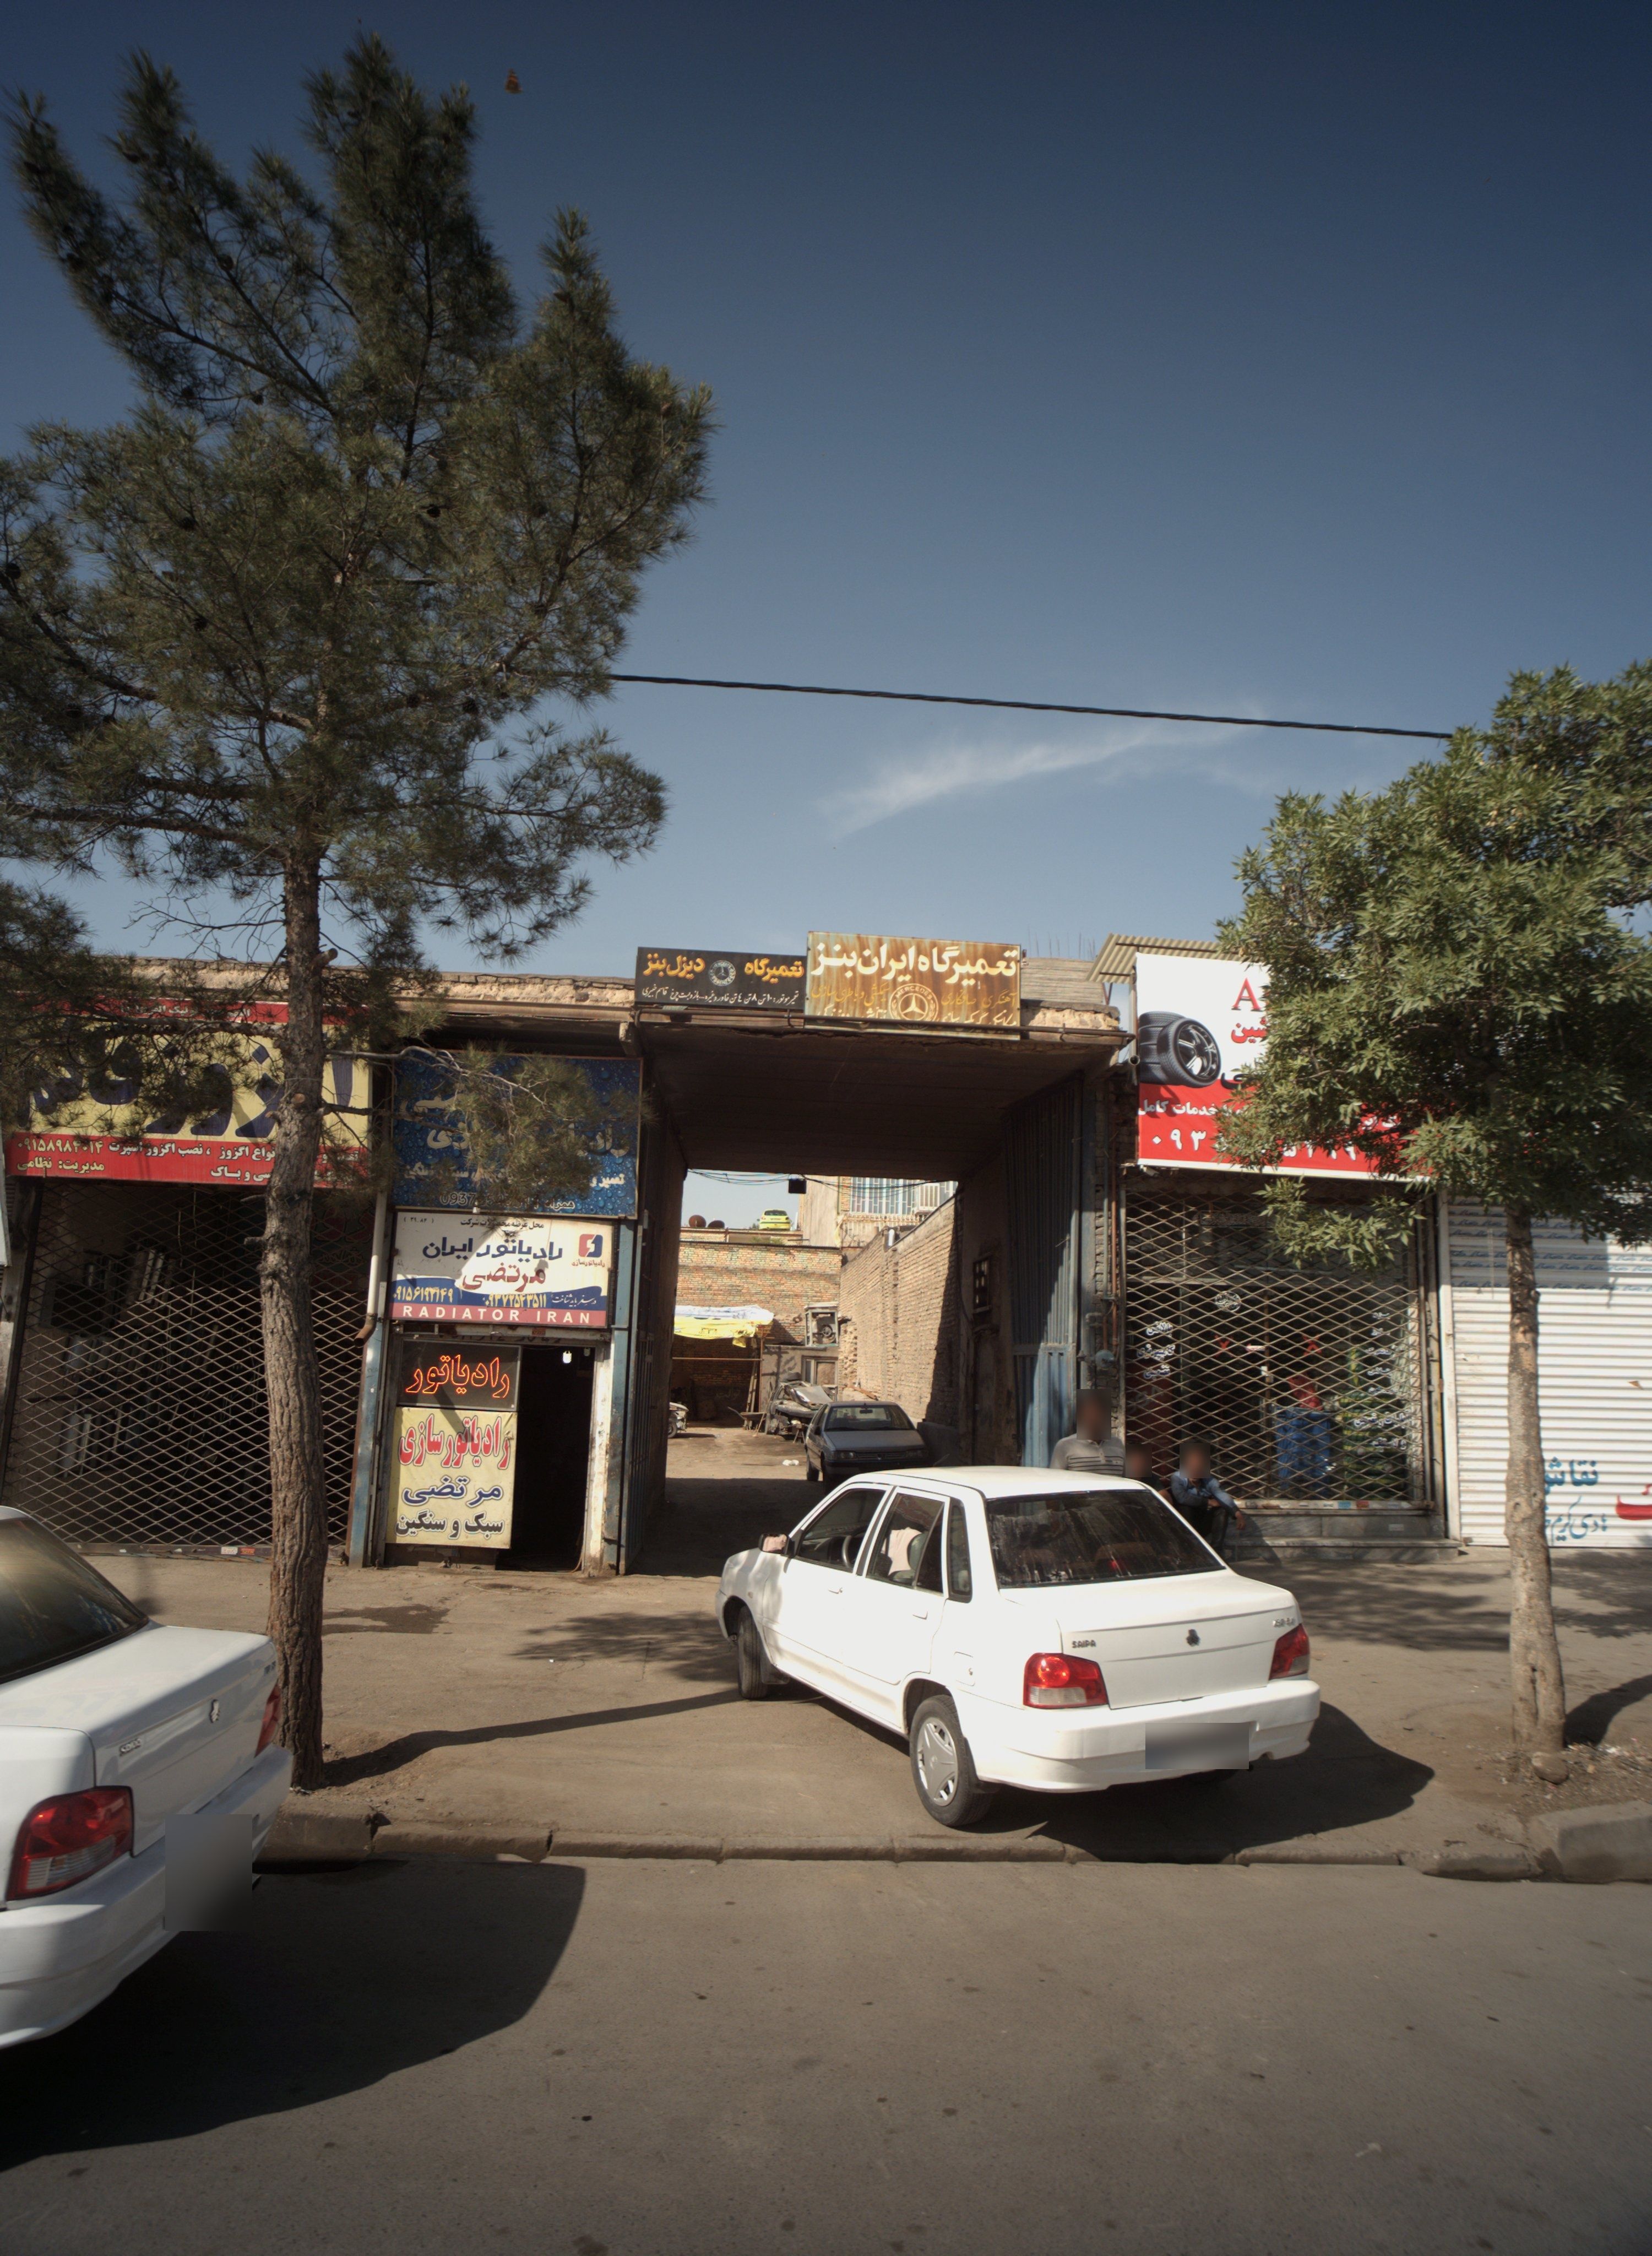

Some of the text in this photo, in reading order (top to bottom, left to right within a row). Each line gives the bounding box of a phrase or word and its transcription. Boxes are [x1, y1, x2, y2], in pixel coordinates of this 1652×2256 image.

[643, 953, 667, 977] بنز
[666, 955, 705, 979] دیزل
[745, 958, 805, 984] تعمیرگاه
[811, 942, 1018, 986] تعمیرگاه ایران بنز
[1138, 1099, 1169, 1115] کامل
[1172, 1101, 1219, 1116] خدمات
[178, 1143, 203, 1158] نصب
[219, 1145, 249, 1160] اگزوز
[252, 1146, 275, 1161] نواع
[17, 1157, 52, 1171] نظامی
[210, 1165, 241, 1180] باک
[460, 1218, 480, 1228] شرکت
[529, 1221, 545, 1230] محل
[422, 1237, 563, 1263] رادیاتور ایران
[463, 1262, 546, 1293] مرتضی
[403, 1305, 590, 1324] RADIATOR IRAN
[405, 1353, 510, 1399] رادیاتور
[398, 1413, 511, 1470] رادیاتور سازی
[403, 1475, 503, 1508] مرتضی
[395, 1509, 504, 1539] سبک و سنگین
